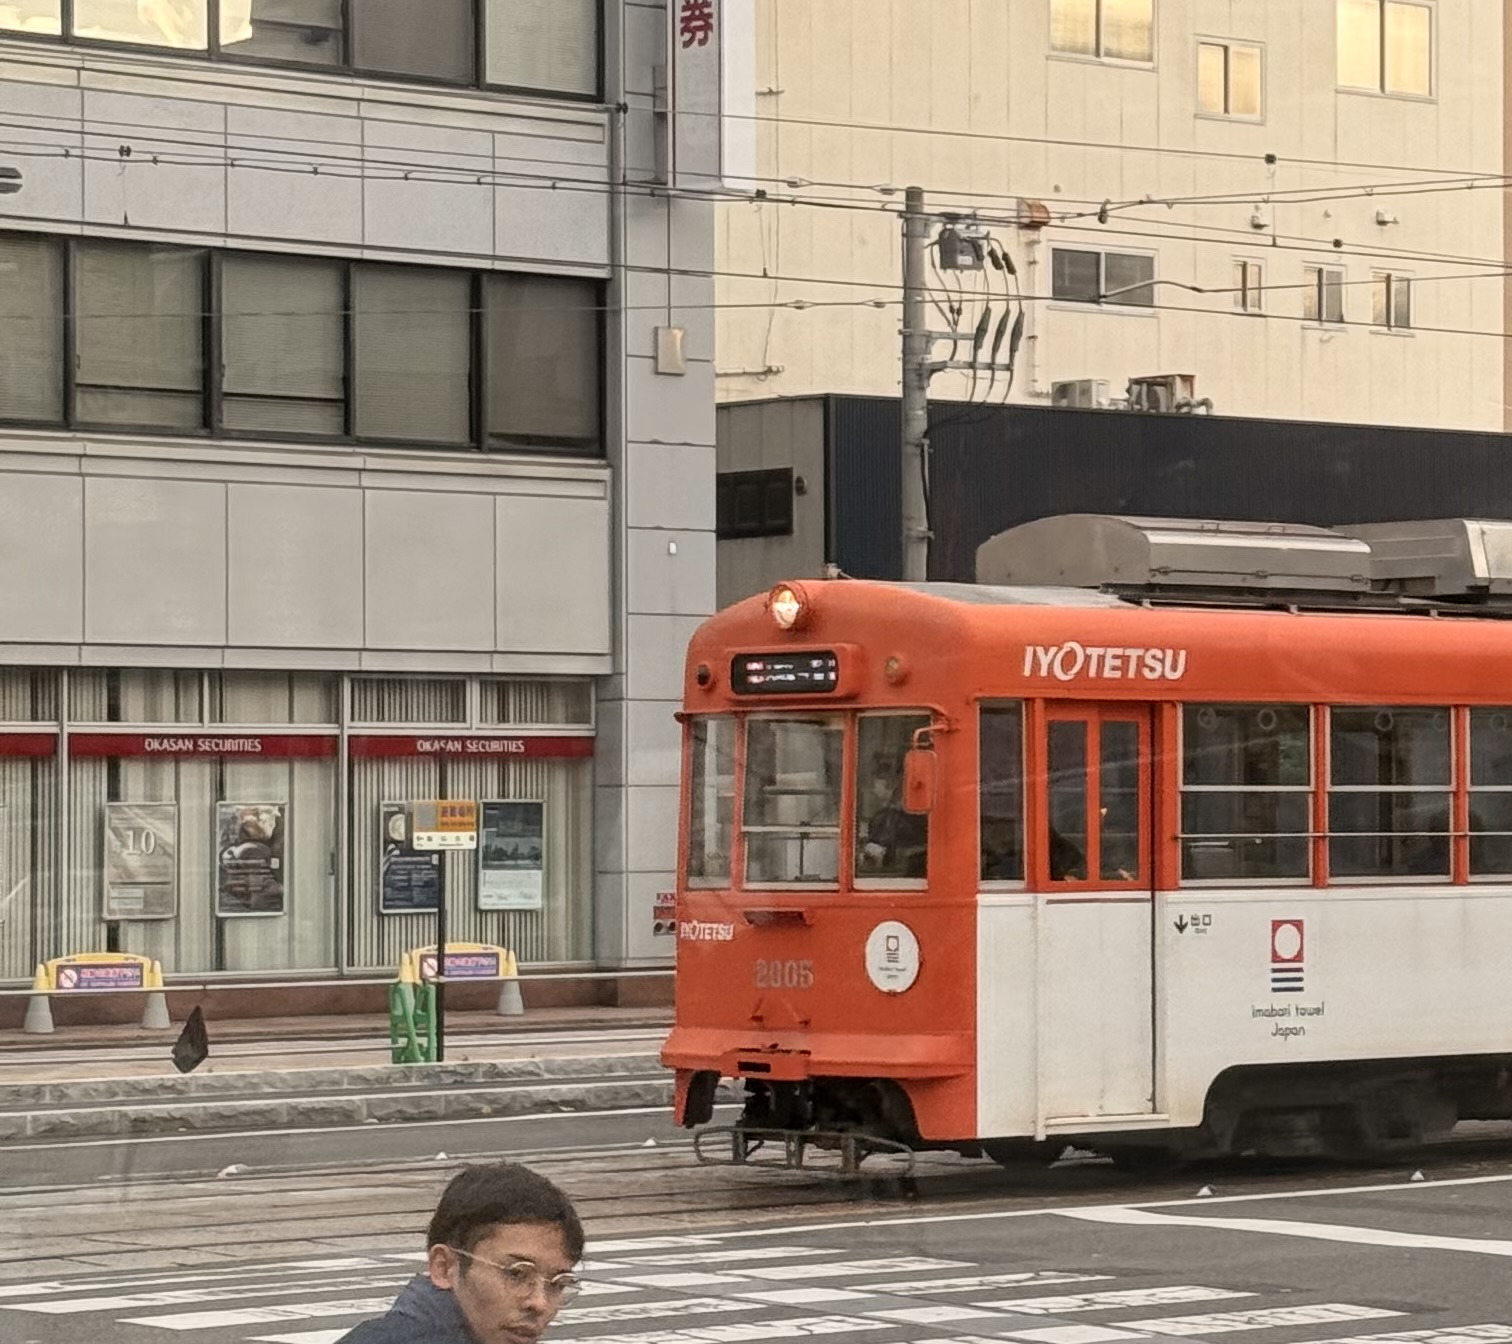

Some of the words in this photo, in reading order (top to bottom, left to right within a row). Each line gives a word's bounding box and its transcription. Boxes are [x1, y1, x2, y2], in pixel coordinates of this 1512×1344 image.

[1023, 641, 1188, 682] IYOTETSU
[144, 738, 194, 752] OKASAN
[197, 738, 262, 753] SECURITIES
[466, 740, 525, 753] SECURITIES
[1251, 1003, 1291, 1018] imabari
[1295, 1001, 1325, 1017] towel
[1271, 1022, 1306, 1042] Japan
